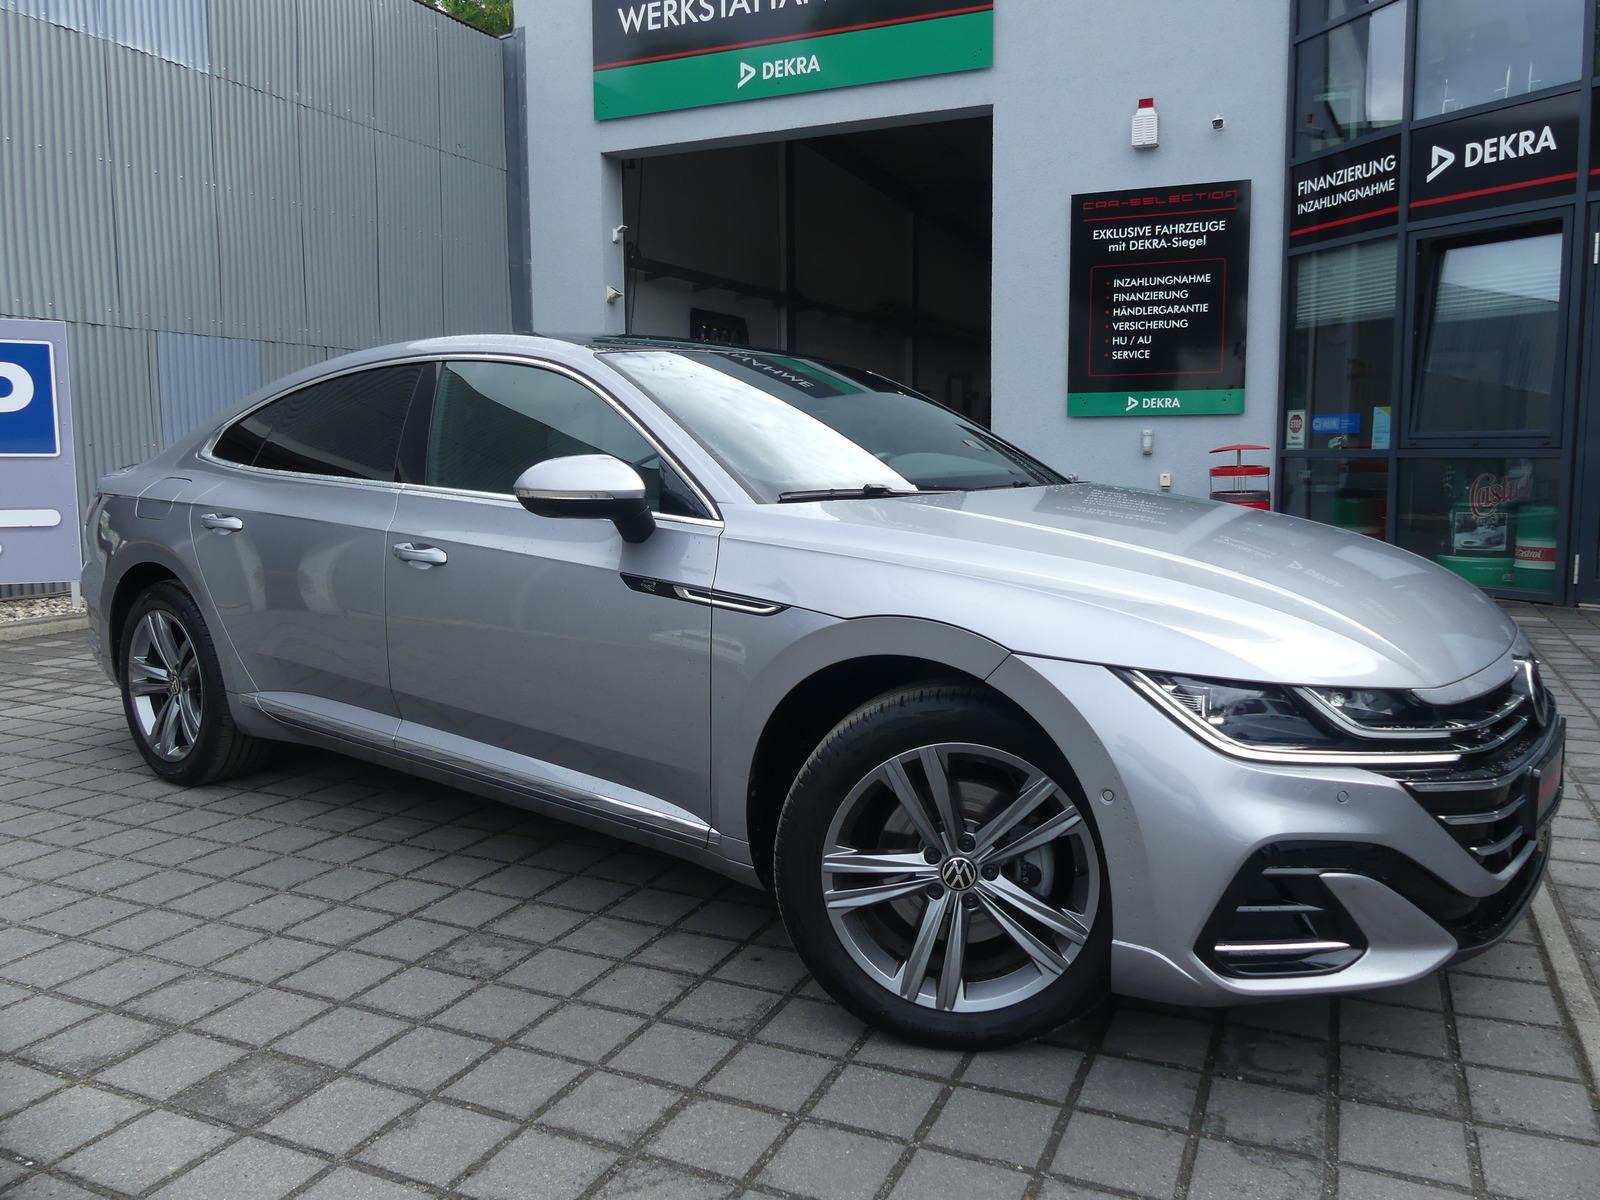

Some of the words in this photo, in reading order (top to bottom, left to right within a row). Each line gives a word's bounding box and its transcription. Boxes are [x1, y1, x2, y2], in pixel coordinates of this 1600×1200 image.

[762, 54, 821, 81] DEKRA
[1464, 125, 1557, 168] DEKRA
[1298, 154, 1397, 197] FINANZIERUNG
[1082, 190, 1238, 209] CAR-SELECTION
[1297, 178, 1396, 215] INZAHLUNGNAHME
[1093, 225, 1152, 240] EXKLUSIVE
[1155, 220, 1226, 236] FAHRZEUGE
[1108, 241, 1126, 252] mit
[1129, 235, 1207, 251] DEKRA-Siegel
[1113, 273, 1212, 288] INZAHLUNGNAHME
[1113, 289, 1189, 302] FINANZIERUNG
[1112, 303, 1209, 317] HÄNDLERGARANTIE
[1112, 319, 1189, 331] VERSICHERUNG
[1112, 336, 1128, 346] HU
[1137, 335, 1152, 345] AU
[1112, 350, 1151, 360] SERVICE
[1142, 397, 1180, 409] DEKRA
